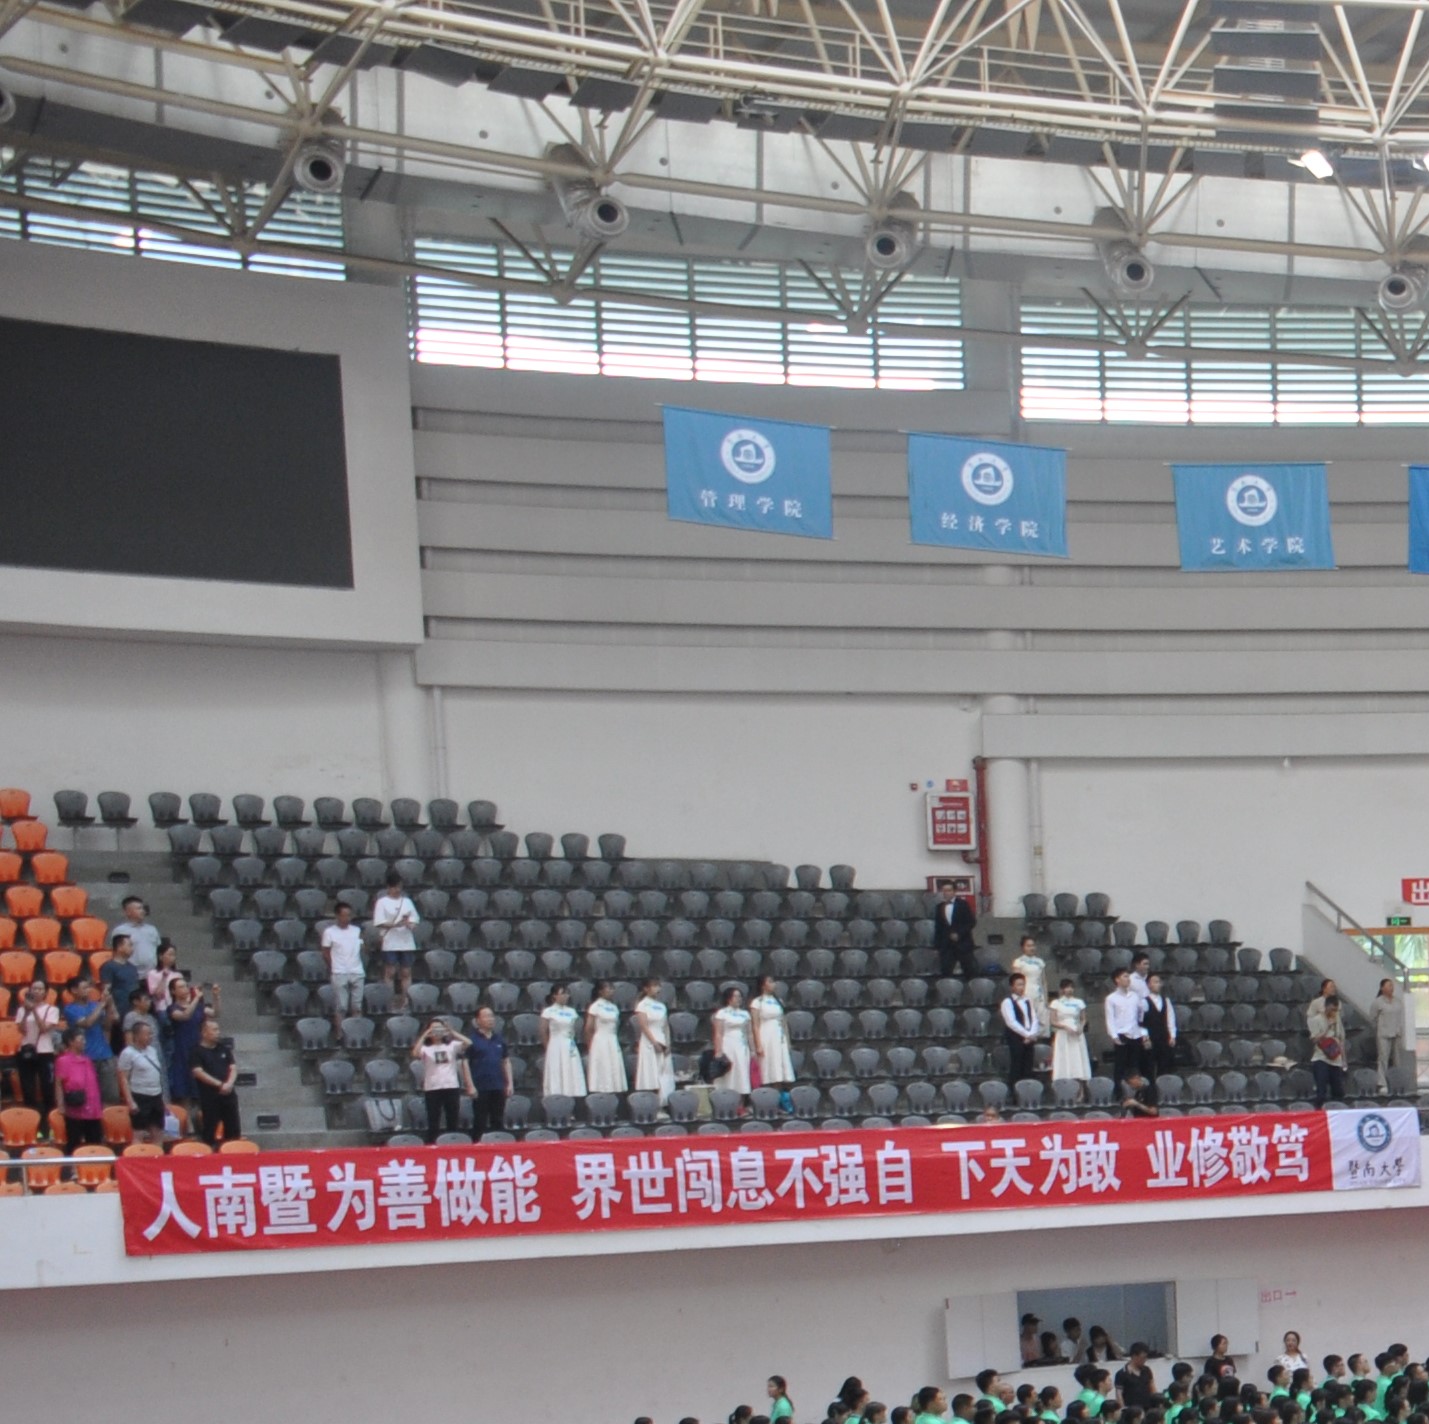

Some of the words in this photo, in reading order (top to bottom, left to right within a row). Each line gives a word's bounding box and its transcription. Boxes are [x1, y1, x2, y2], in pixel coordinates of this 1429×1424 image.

[700, 489, 803, 518] 管理学院
[940, 512, 1039, 538] 经济学院
[1209, 536, 1305, 556] 艺术学院
